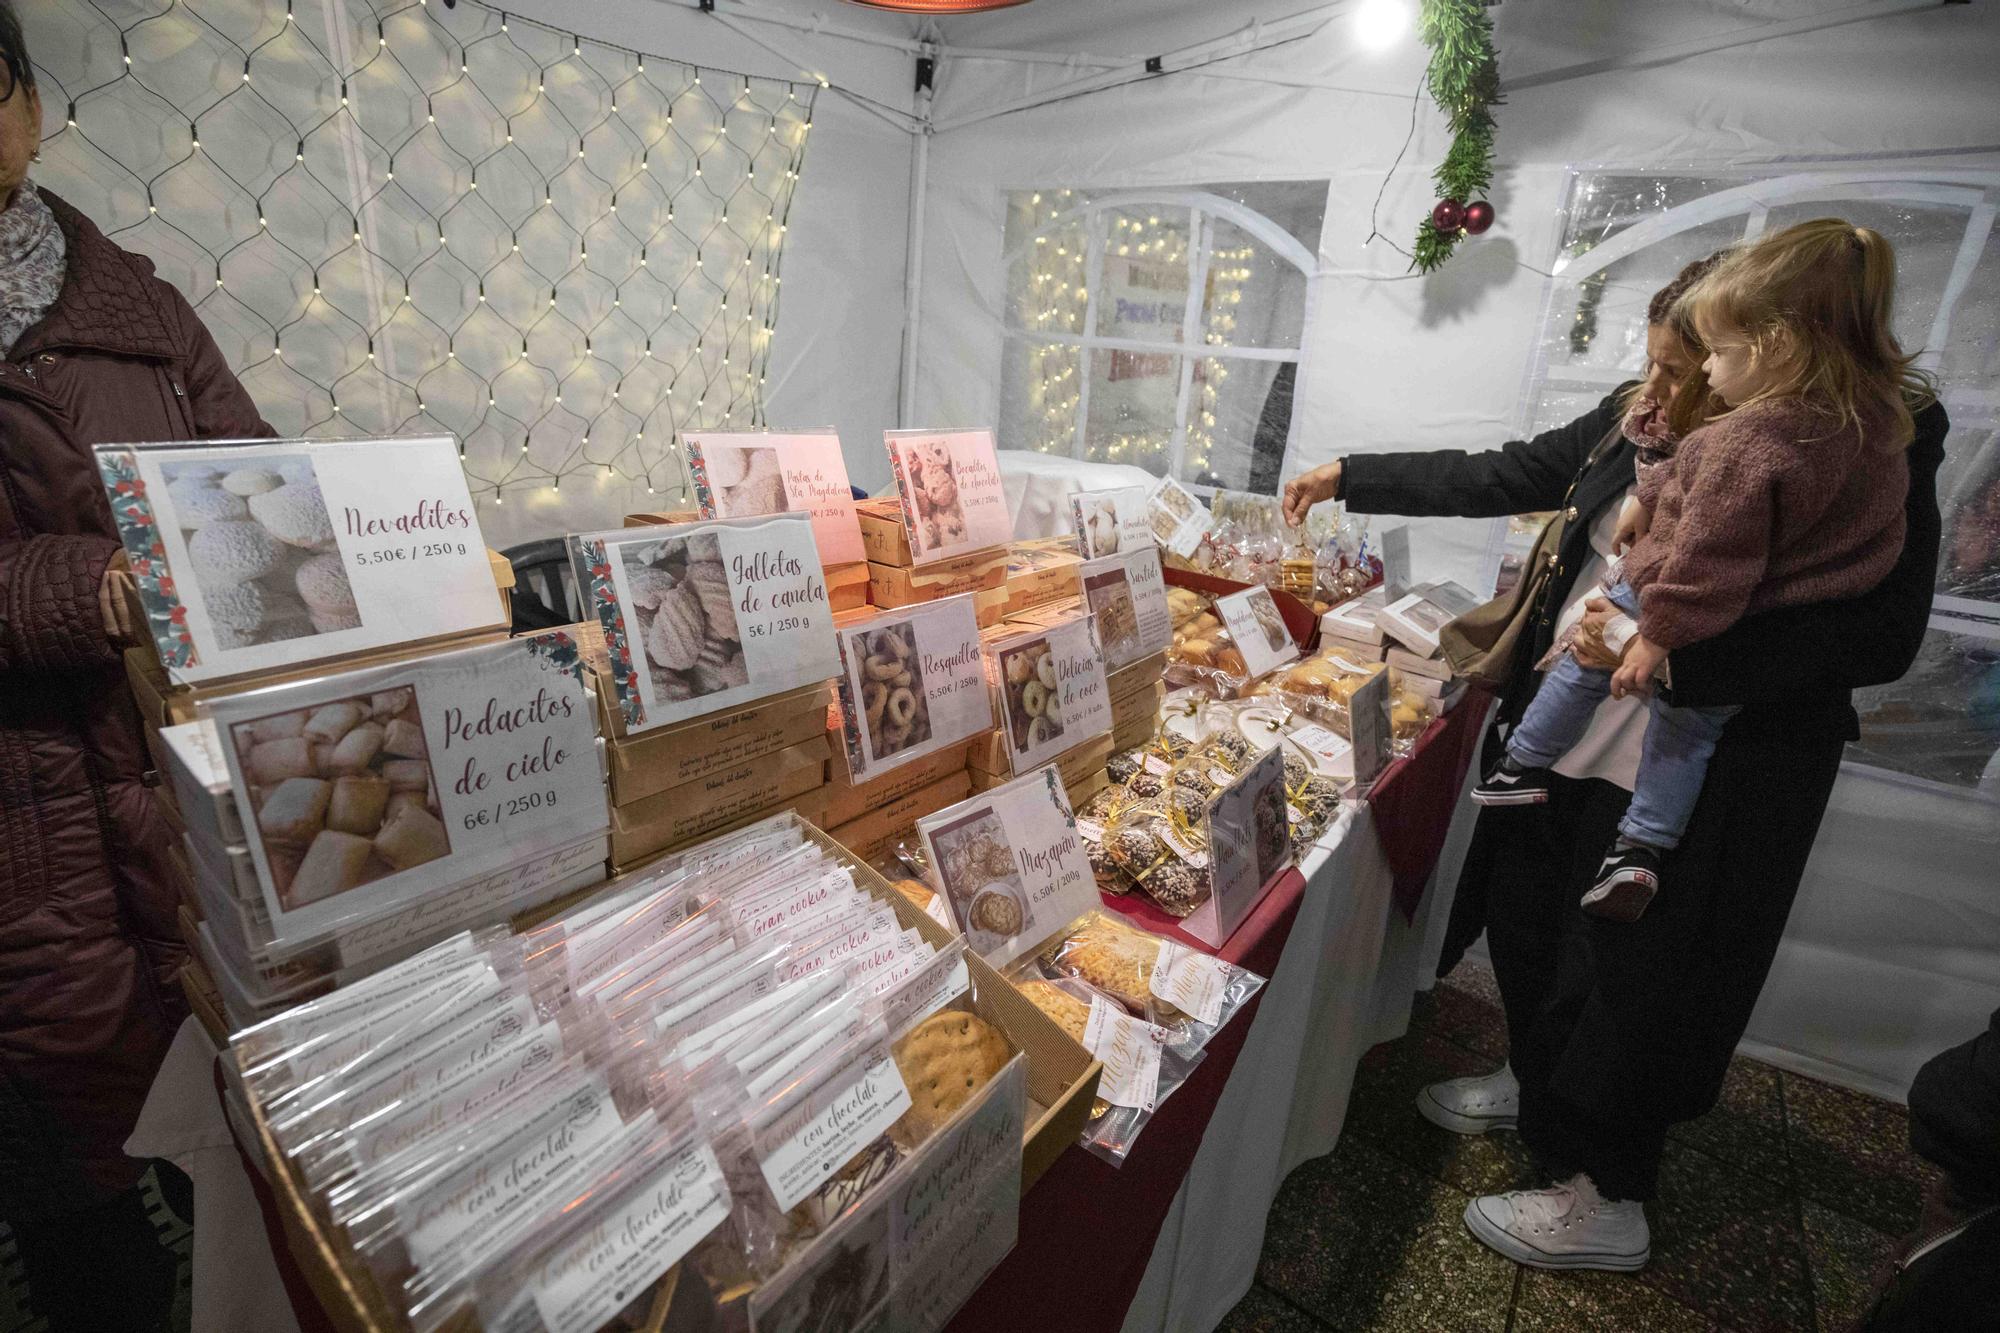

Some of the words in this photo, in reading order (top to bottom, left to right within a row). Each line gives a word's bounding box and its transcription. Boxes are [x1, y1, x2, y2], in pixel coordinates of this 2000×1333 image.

[344, 499, 472, 537] Nevaditos
[412, 546, 417, 561] /
[423, 543, 452, 557] 250
[457, 543, 466, 556] g
[733, 550, 803, 585] Galletas
[741, 585, 762, 613] de
[772, 575, 824, 608] canela
[749, 624, 765, 638] 5€
[769, 622, 773, 635] /
[777, 617, 799, 632] 250
[803, 617, 810, 629] g
[924, 642, 979, 677] Rosquillas
[1059, 656, 1093, 681] Delicias
[930, 684, 952, 700] 5,50€
[960, 676, 978, 689] 250g
[1064, 683, 1074, 705] de
[1080, 682, 1099, 699] coco
[445, 687, 575, 750] Pedacitos
[455, 757, 491, 795] de
[506, 736, 572, 782] cielo
[464, 809, 490, 830] 6€
[495, 803, 501, 823] /
[507, 792, 541, 816] 250
[546, 790, 557, 807] g
[1020, 836, 1075, 878] Mazapán
[1033, 883, 1056, 903] 6,50€
[1062, 870, 1081, 886] 200g
[753, 914, 785, 937] Gran
[790, 887, 828, 915] cookie
[790, 956, 824, 979] Gran
[829, 930, 870, 960] cookie
[803, 1125, 823, 1147] con
[827, 1079, 877, 1130] chocolate
[468, 1185, 496, 1214] con
[504, 1125, 574, 1189] chocolate
[589, 1243, 616, 1273] con
[621, 1182, 684, 1246] chocolate
